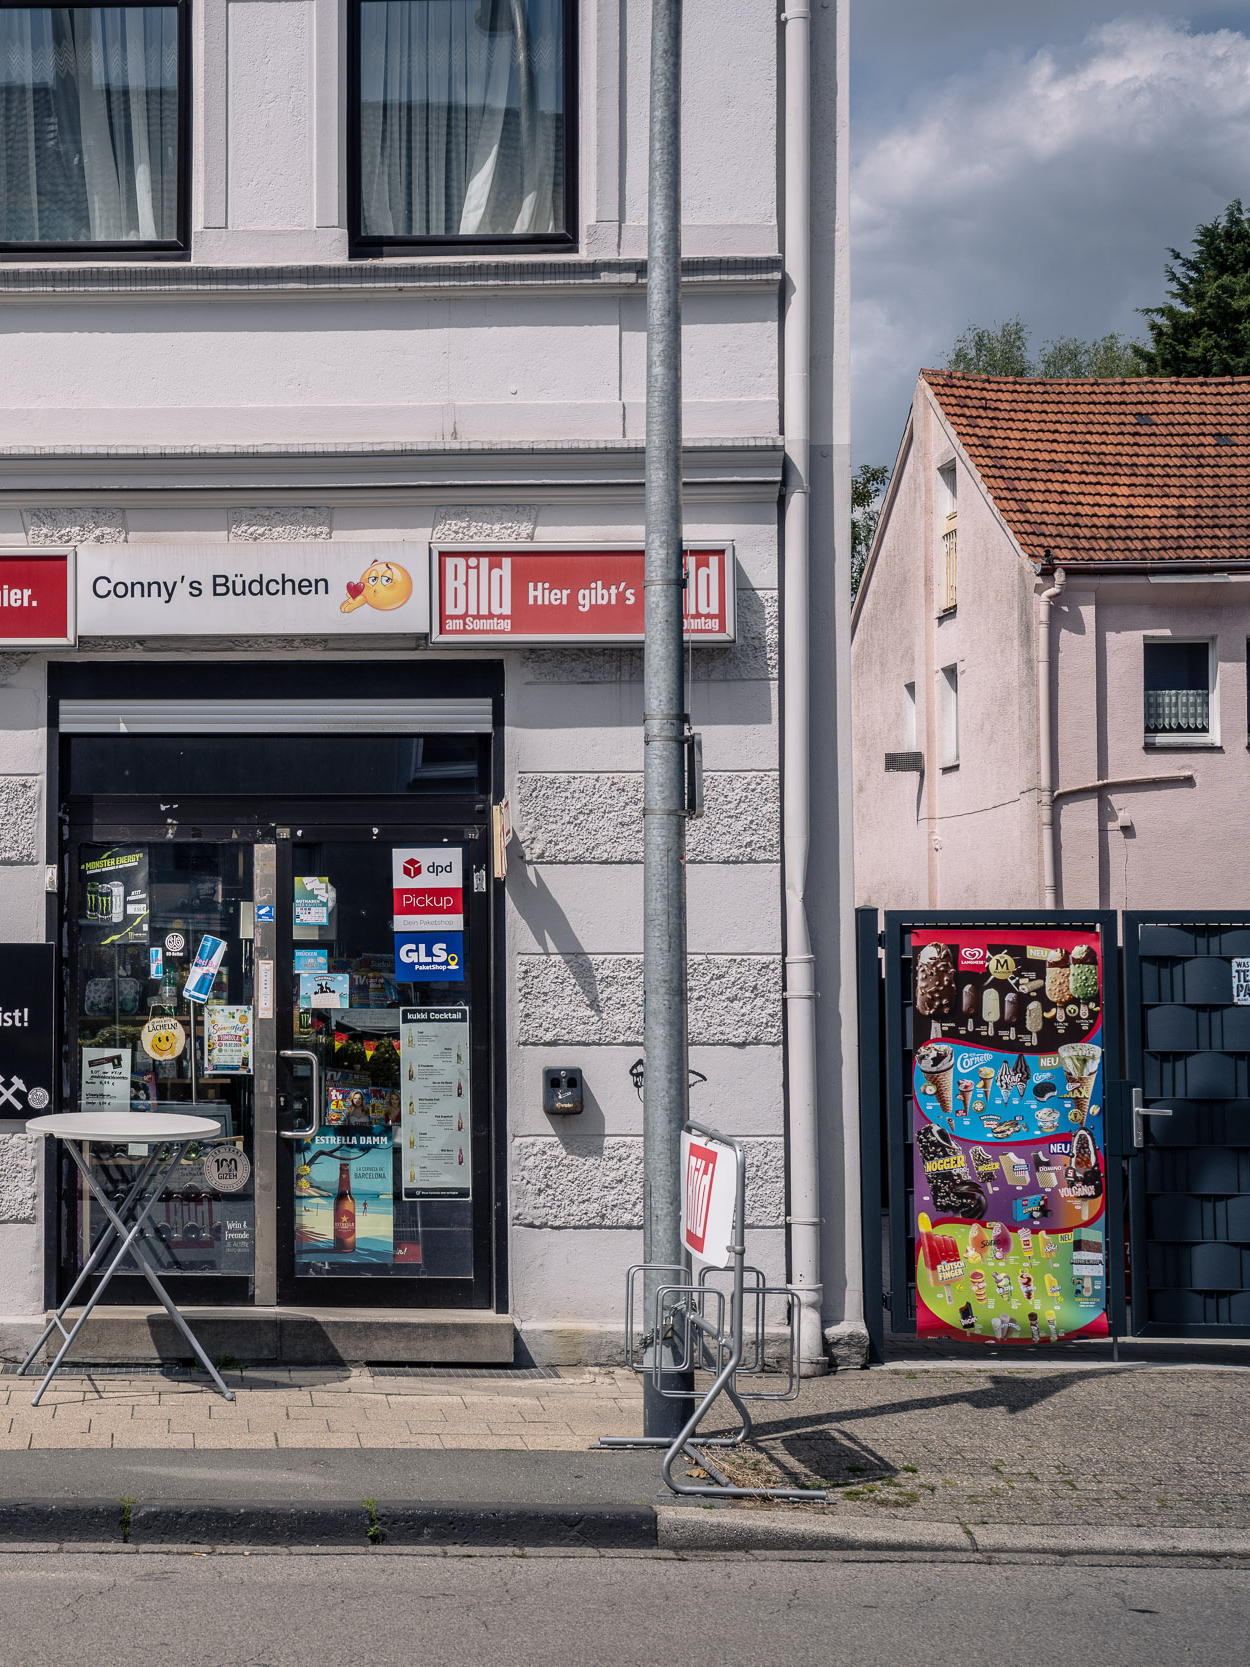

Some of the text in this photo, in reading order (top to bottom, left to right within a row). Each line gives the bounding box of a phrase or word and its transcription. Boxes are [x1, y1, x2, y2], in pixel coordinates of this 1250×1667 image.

[211, 573, 329, 597] Büdchen
[446, 557, 511, 615] Bild
[683, 556, 719, 615] ld
[528, 581, 635, 612] Hier gibt's
[445, 617, 511, 631] am Sonntag
[86, 858, 115, 871] MONSTER
[116, 853, 139, 865] ENERGY
[427, 861, 453, 876] dpd
[403, 894, 454, 909] Pickup
[420, 919, 453, 927] Paketshop
[399, 943, 448, 963] GLS
[1030, 949, 1047, 957] NEU
[407, 1012, 428, 1020] kukki
[956, 1053, 994, 1074] Cornetto
[1040, 1057, 1059, 1067] NEU
[315, 1136, 388, 1144] ESTRELLA DAMM
[1050, 1144, 1070, 1154] NEU
[925, 1155, 966, 1173] NOGGER
[978, 1162, 999, 1172] NOGGER
[687, 1155, 713, 1239] Bild
[226, 1220, 242, 1230] Wein
[225, 1230, 250, 1240] Freunde
[1060, 1234, 1072, 1242] NEU
[937, 1261, 966, 1273] FLUTSCH
[939, 1268, 964, 1281] FINGER
